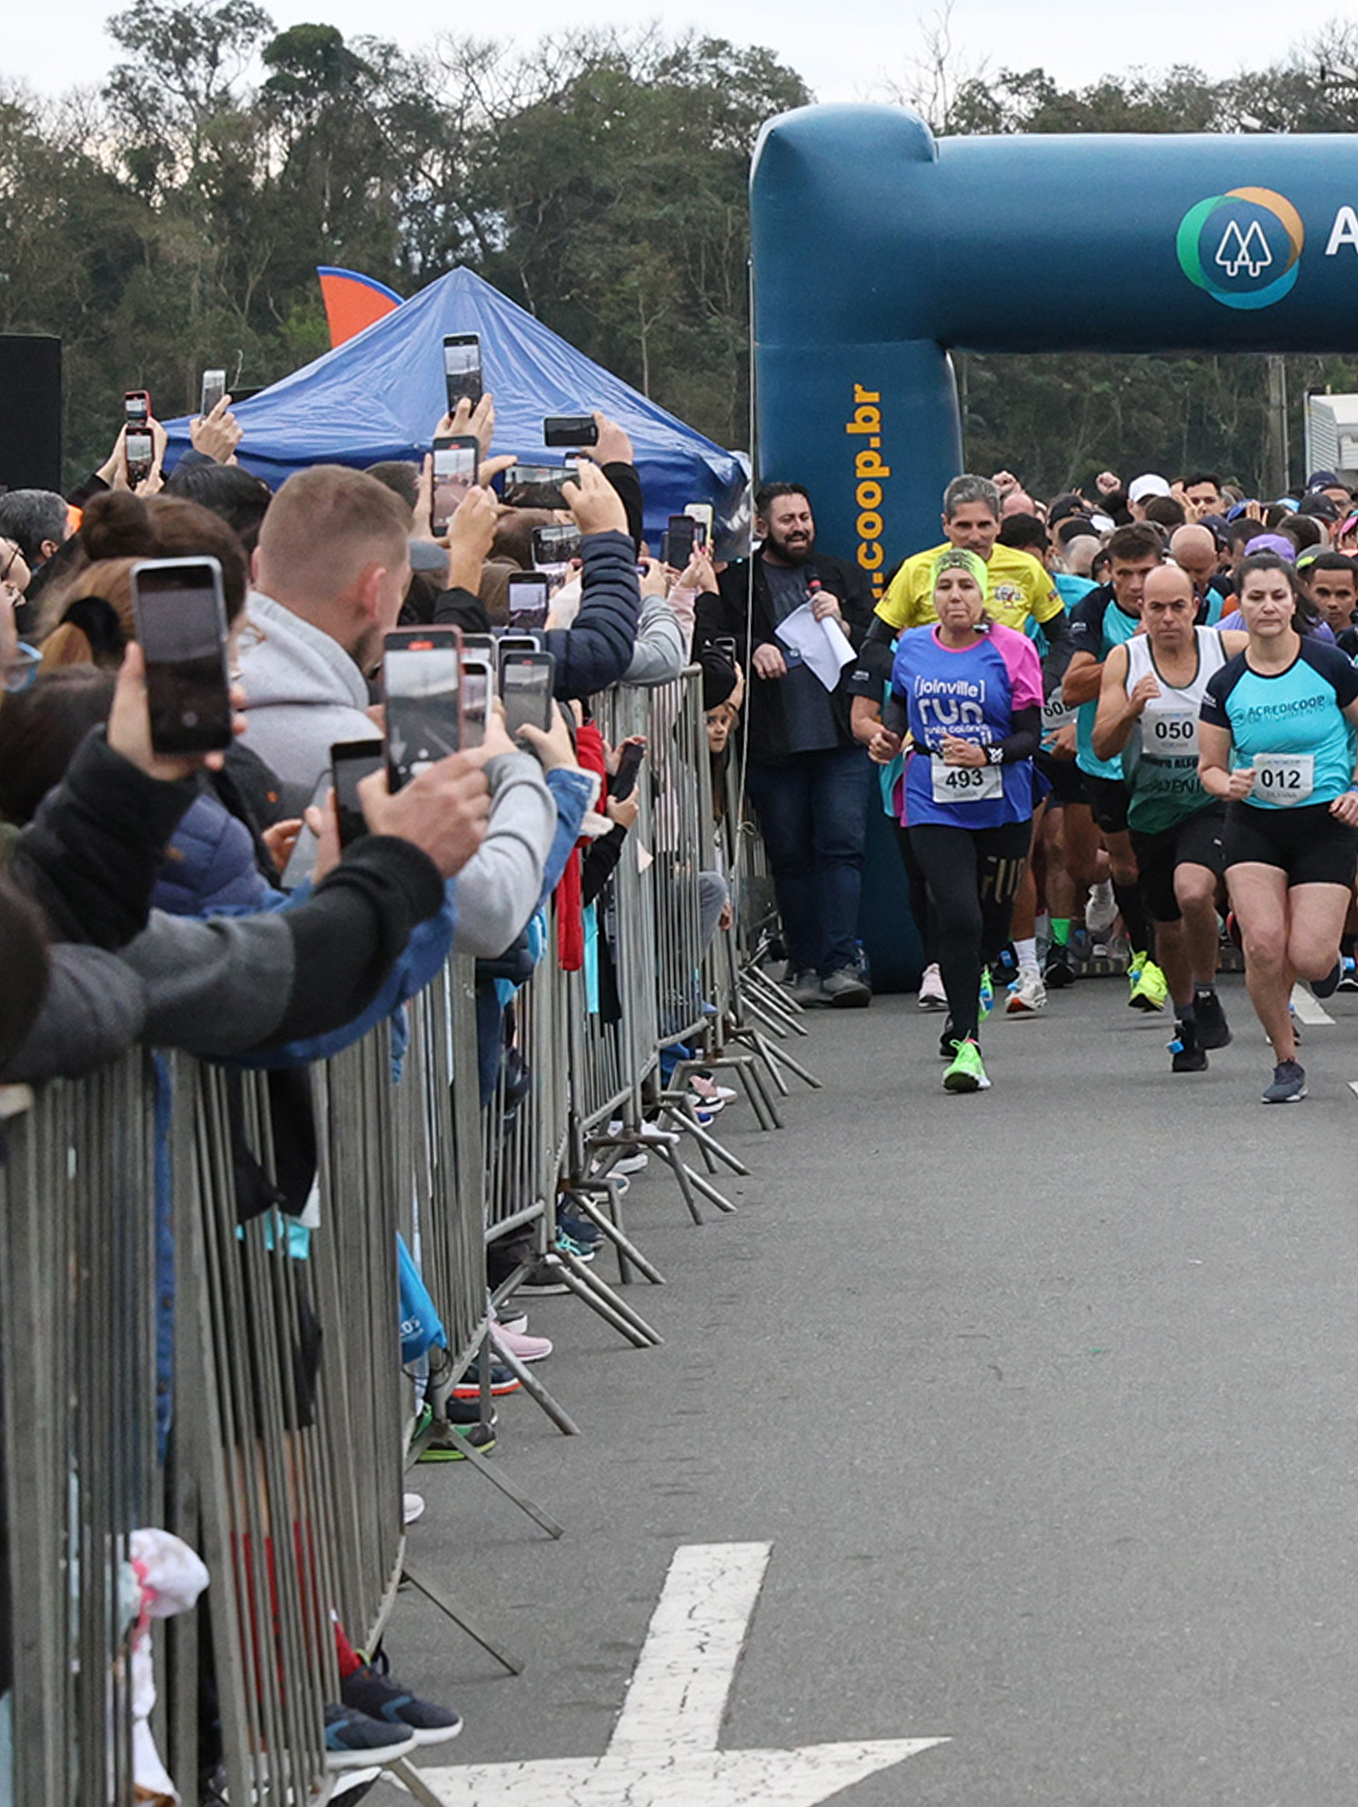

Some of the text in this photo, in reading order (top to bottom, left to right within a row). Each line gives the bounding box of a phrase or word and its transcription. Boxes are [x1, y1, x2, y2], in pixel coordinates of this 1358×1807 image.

[846, 383, 890, 599] .coop.br
[918, 698, 984, 725] run
[1155, 721, 1194, 739] 050
[945, 768, 984, 788] 493
[1261, 769, 1301, 788] 012
